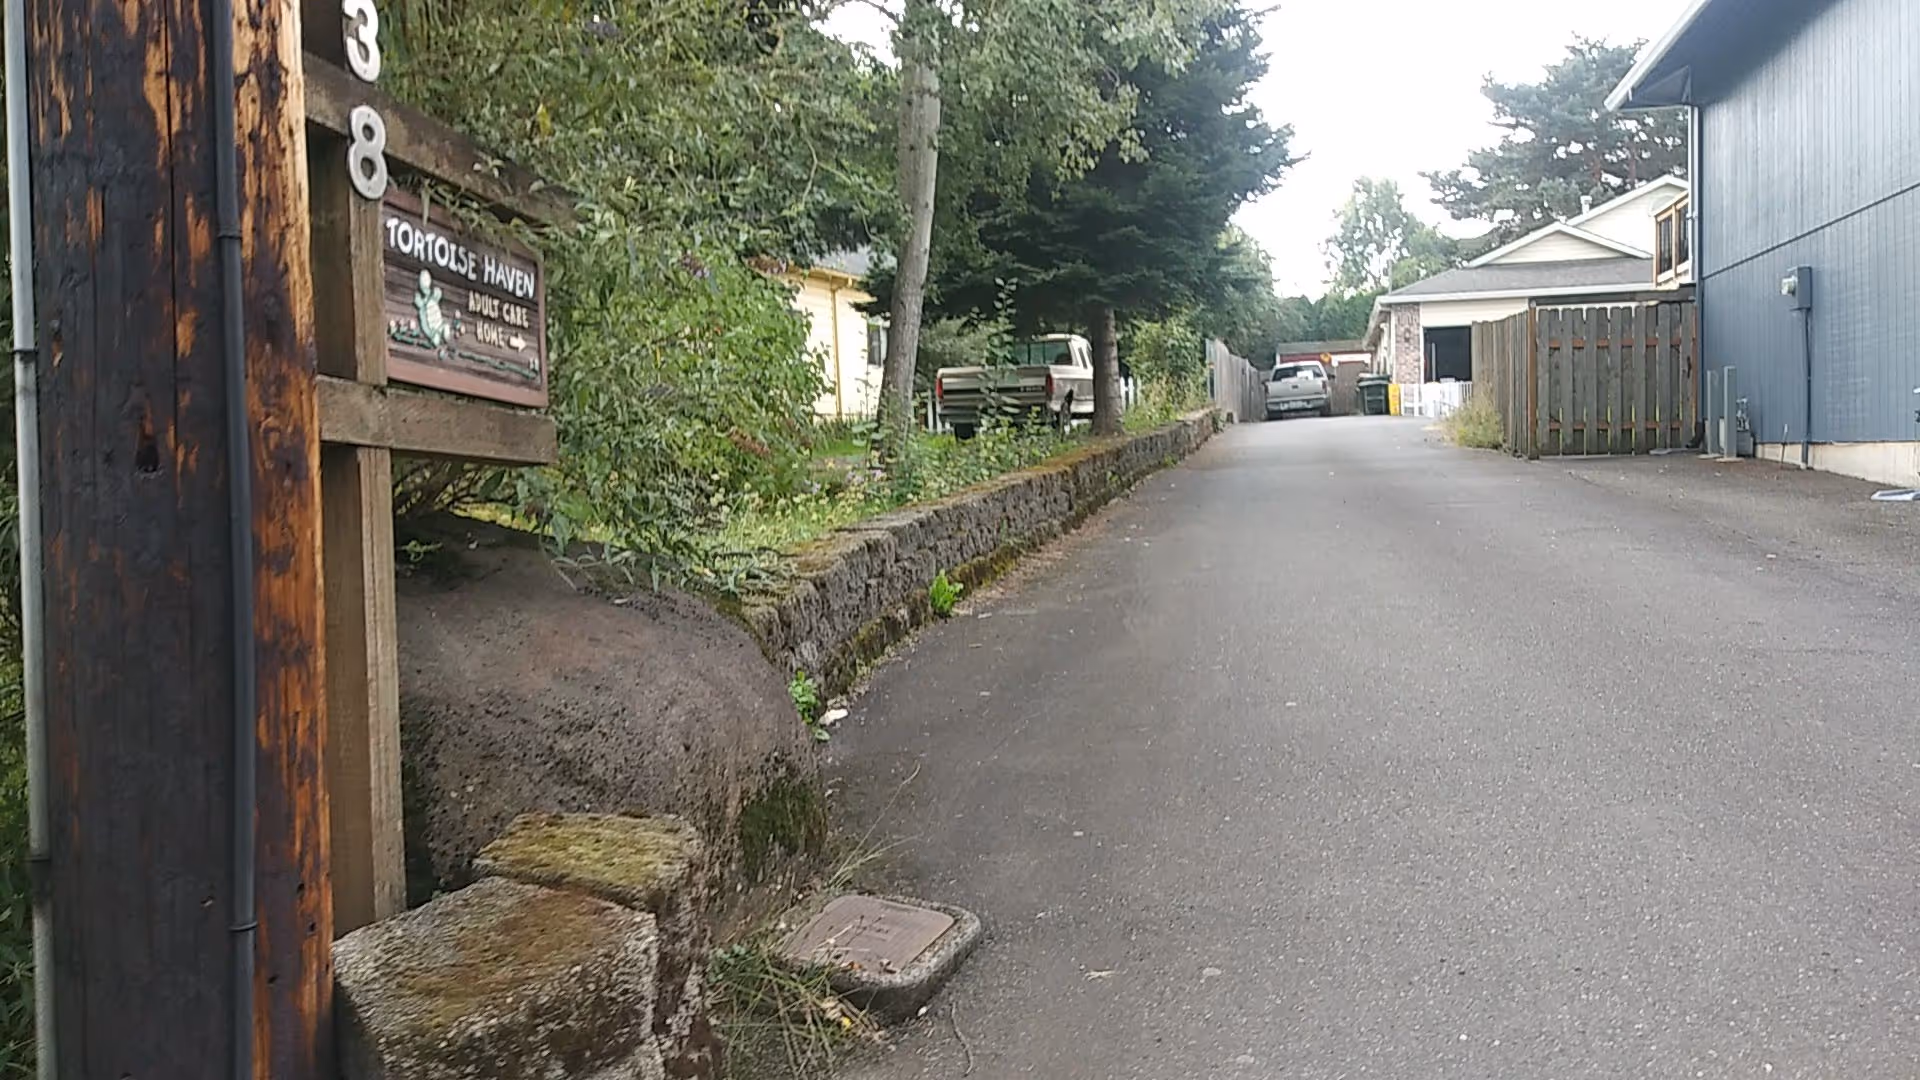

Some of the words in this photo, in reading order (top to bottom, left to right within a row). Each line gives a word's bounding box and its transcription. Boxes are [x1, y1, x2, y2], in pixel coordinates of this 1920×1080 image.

[386, 217, 477, 281] TORTOISE
[484, 254, 536, 299] HAVEN
[468, 290, 499, 319] ADULT
[502, 302, 529, 329] CARE
[476, 320, 506, 348] HOME
